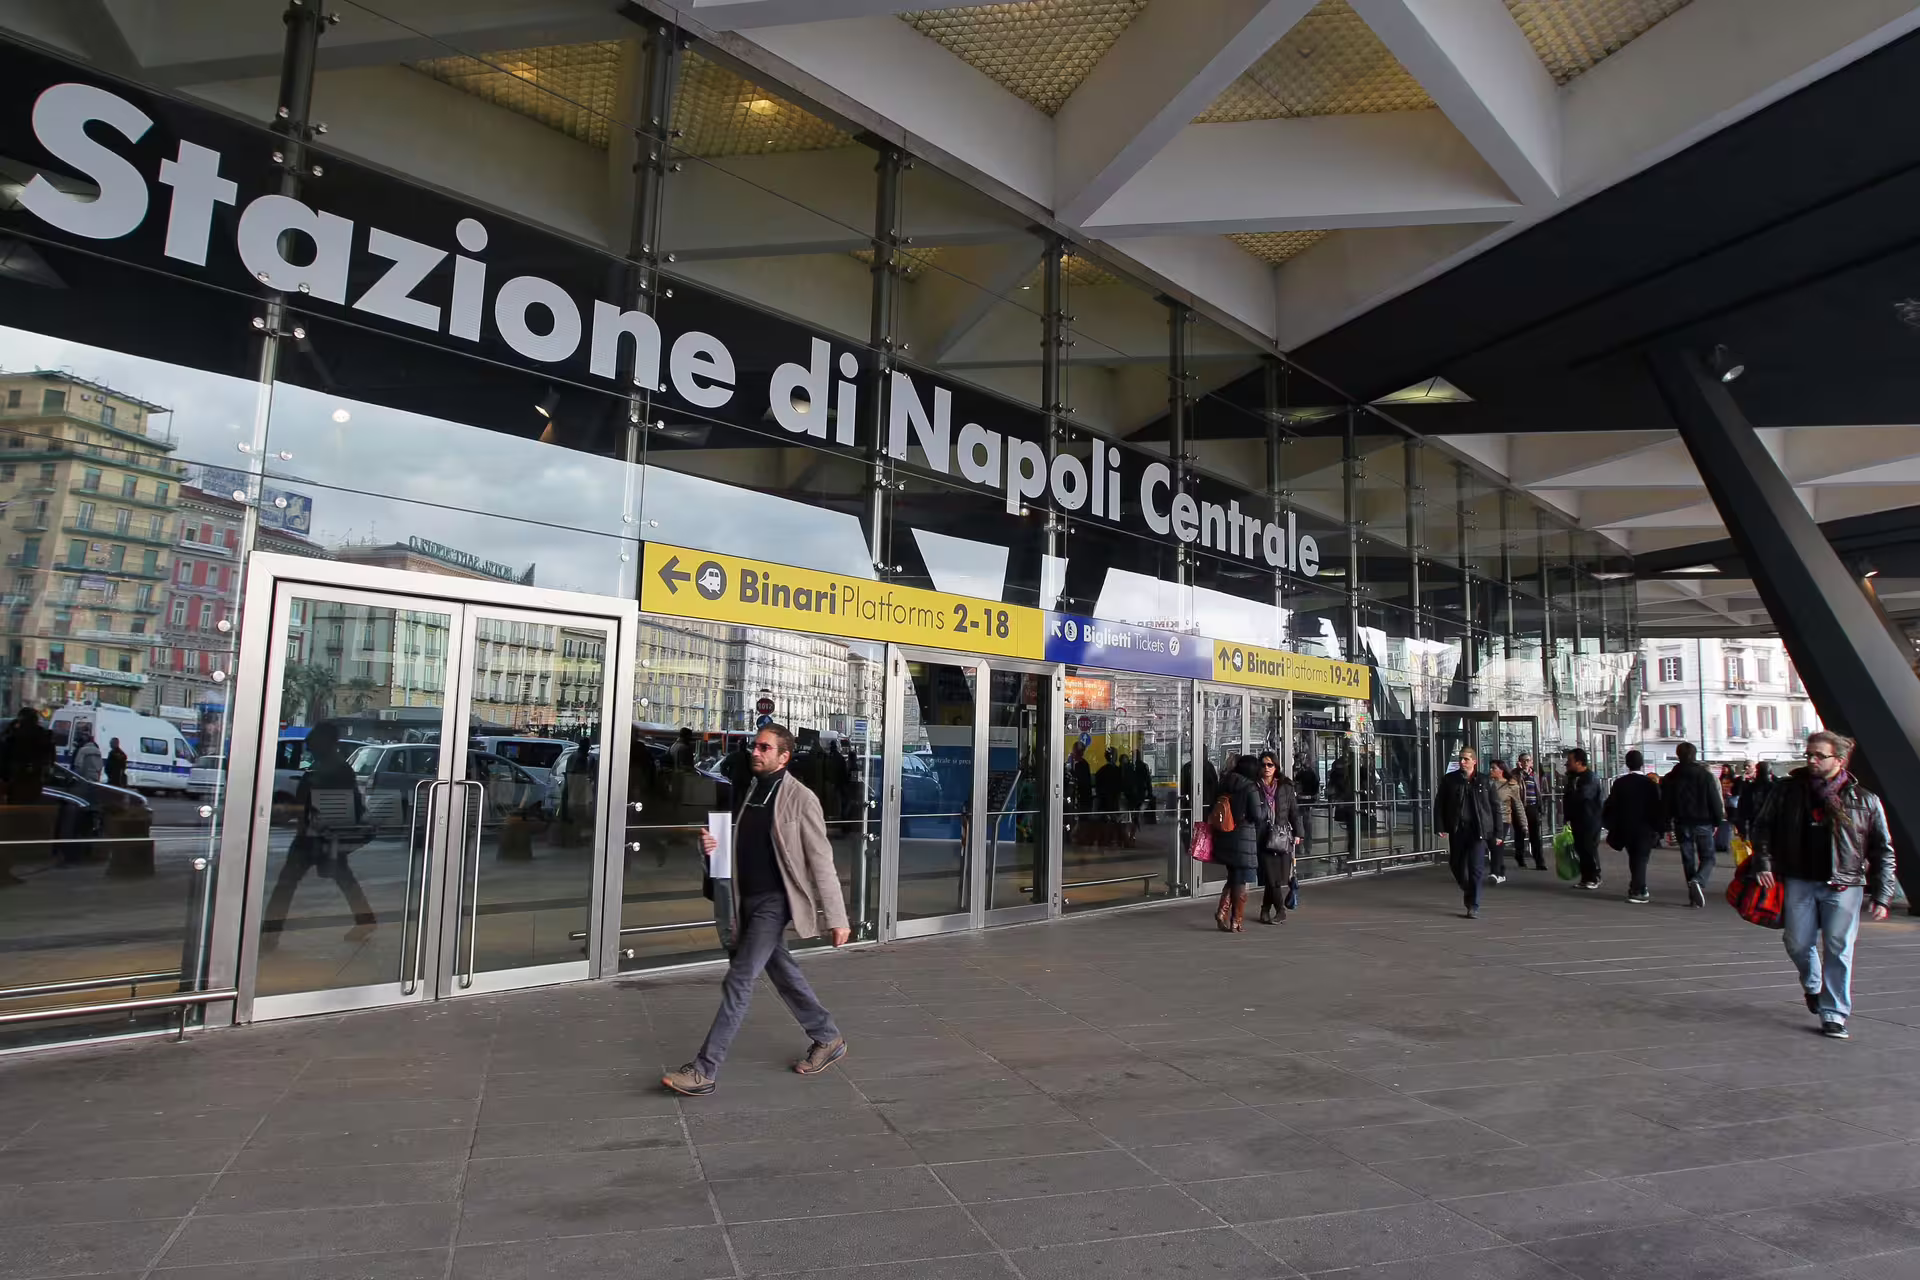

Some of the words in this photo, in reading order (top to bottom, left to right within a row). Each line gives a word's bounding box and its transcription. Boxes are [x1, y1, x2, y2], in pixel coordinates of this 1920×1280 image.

[16, 83, 736, 408] Stazione
[769, 337, 859, 447] di
[888, 370, 1121, 522] Napoli
[1140, 462, 1320, 577] Centrale
[739, 568, 837, 615] Binari
[842, 585, 945, 630] Platforms
[953, 603, 1010, 639] 2-18
[1083, 625, 1131, 648] Biglietti
[1133, 633, 1165, 654] Tickets
[1247, 651, 1285, 678] Binari
[1286, 658, 1328, 683] Platforms
[1329, 664, 1360, 688] 19-24
